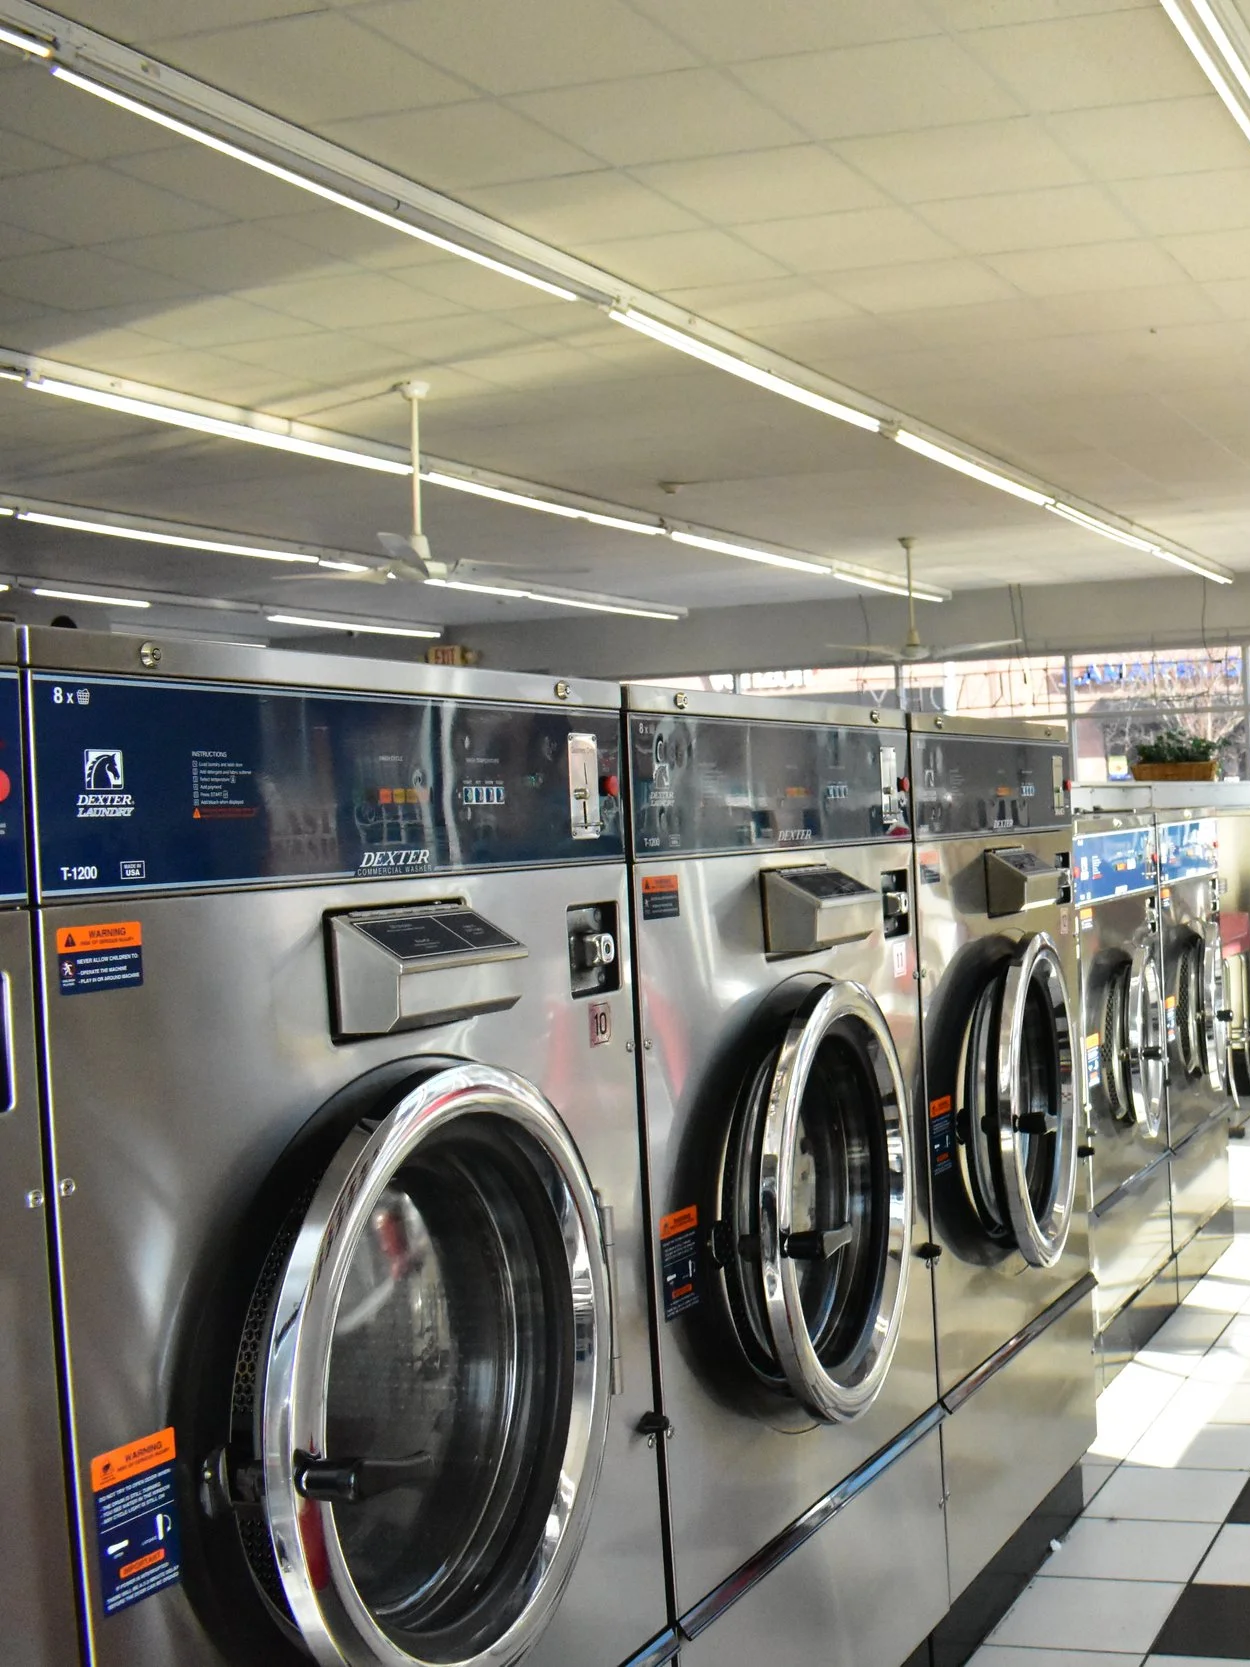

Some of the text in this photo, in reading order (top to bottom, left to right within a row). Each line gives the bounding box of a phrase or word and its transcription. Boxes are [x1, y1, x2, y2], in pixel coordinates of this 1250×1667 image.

[435, 646, 456, 665] EXIT
[53, 687, 63, 704] 8
[76, 794, 133, 806] DEXTER
[77, 807, 134, 818] LAUNDRY
[993, 819, 1014, 829] DEXTER
[778, 829, 812, 841] DEXTER
[359, 849, 431, 868] DEXTER
[61, 866, 98, 880] T-1200
[357, 864, 432, 877] COMMERCIAL WASHER
[89, 927, 126, 938] WARNING
[77, 957, 93, 965] NEVER
[594, 1012, 607, 1036] 10
[125, 1440, 161, 1463] WARNING
